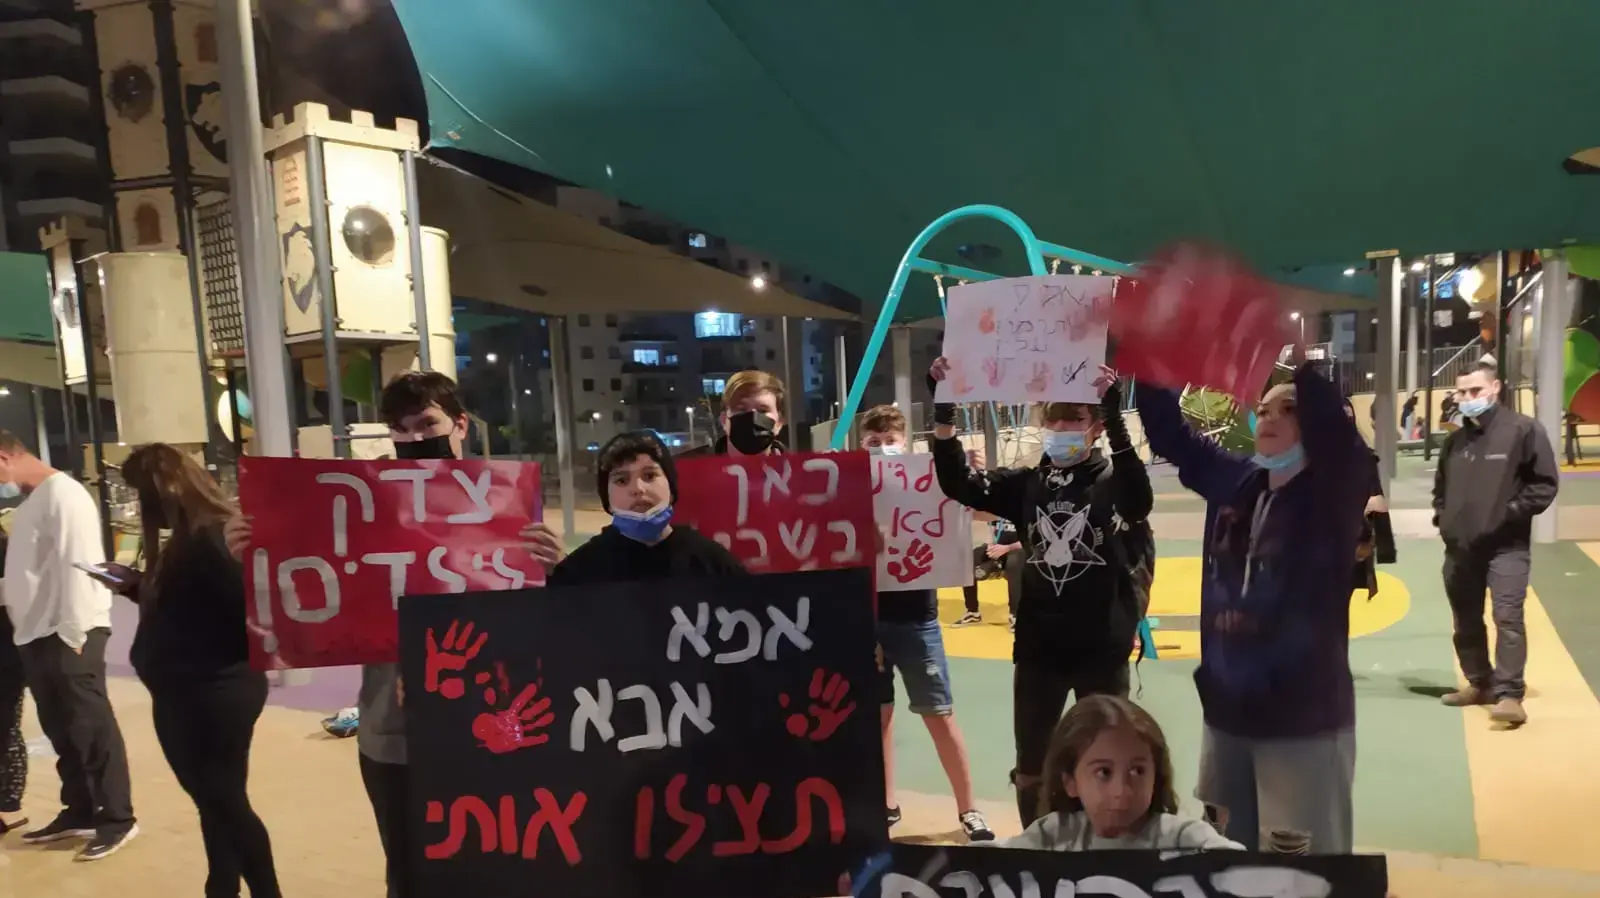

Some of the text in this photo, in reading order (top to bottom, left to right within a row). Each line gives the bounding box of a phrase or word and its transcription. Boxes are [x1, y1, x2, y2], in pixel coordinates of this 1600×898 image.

[315, 468, 494, 557] צדק
[723, 457, 840, 527] כאן
[666, 596, 814, 664] אמא
[569, 678, 716, 753] אבא
[424, 773, 847, 867] תצילו אותי
